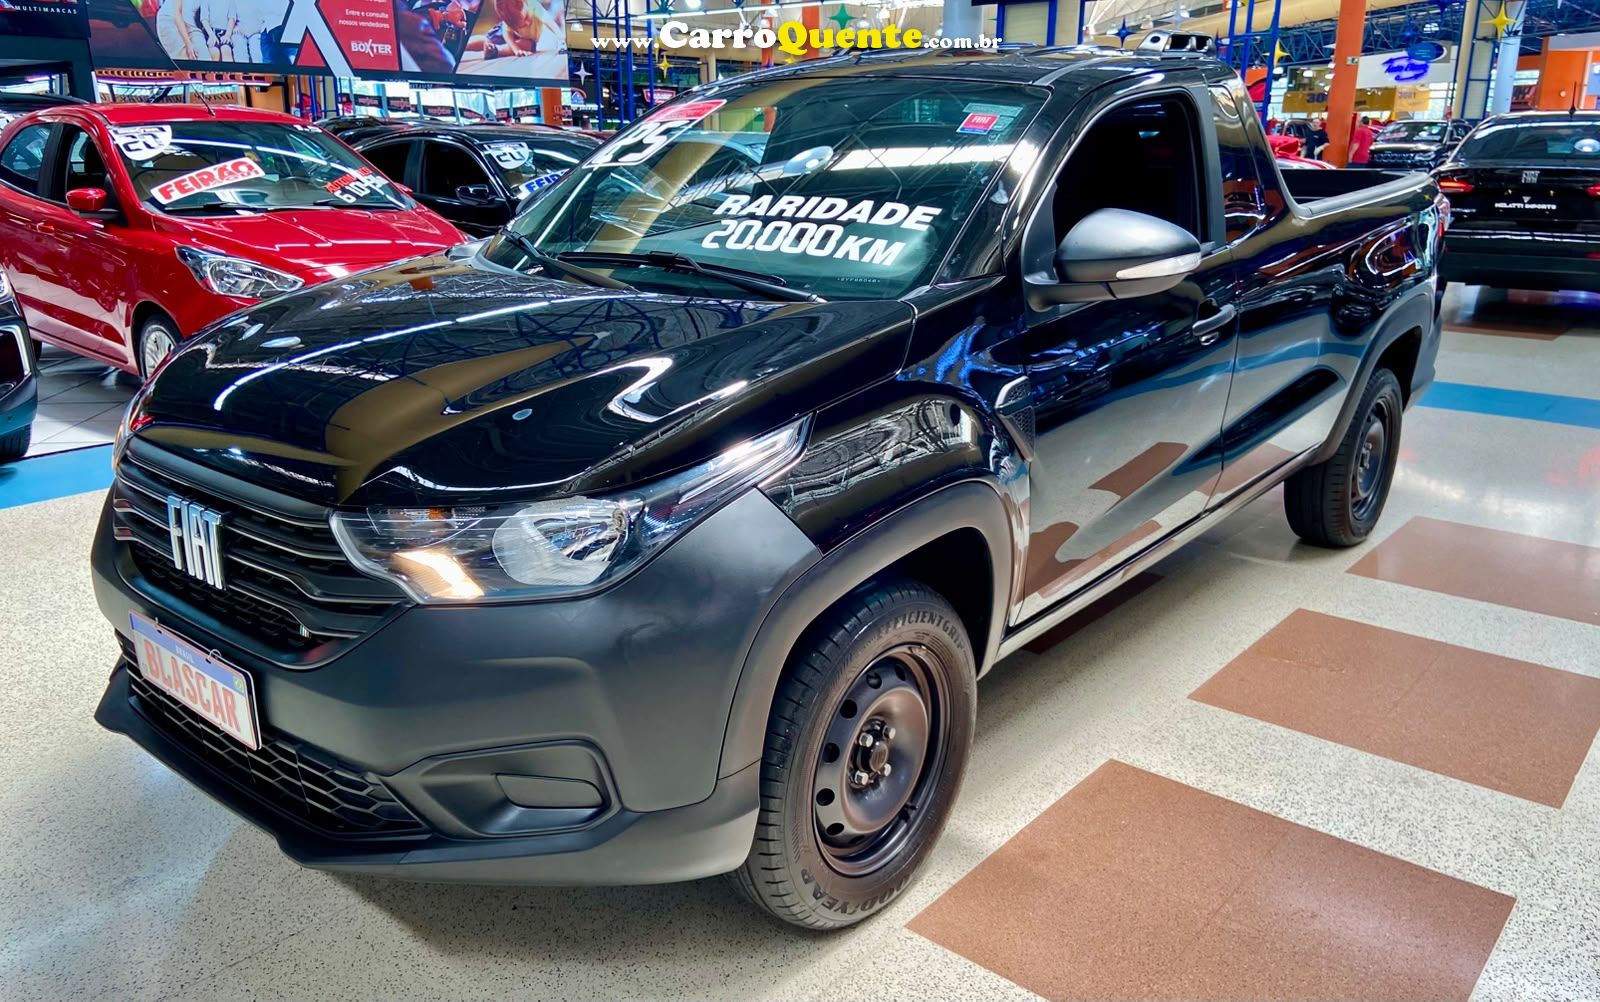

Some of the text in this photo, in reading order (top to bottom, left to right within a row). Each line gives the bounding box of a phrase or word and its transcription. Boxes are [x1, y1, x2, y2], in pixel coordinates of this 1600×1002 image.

[14, 5, 77, 15] MULTIMARCAS
[345, 8, 360, 17] Entre
[338, 19, 390, 29] nossos vendedores
[351, 39, 392, 58] BOXTER
[158, 160, 256, 201] FEIRÃO
[713, 195, 943, 231] RARIDADE
[167, 494, 223, 590] FIAT
[143, 639, 241, 733] BLASCAR
